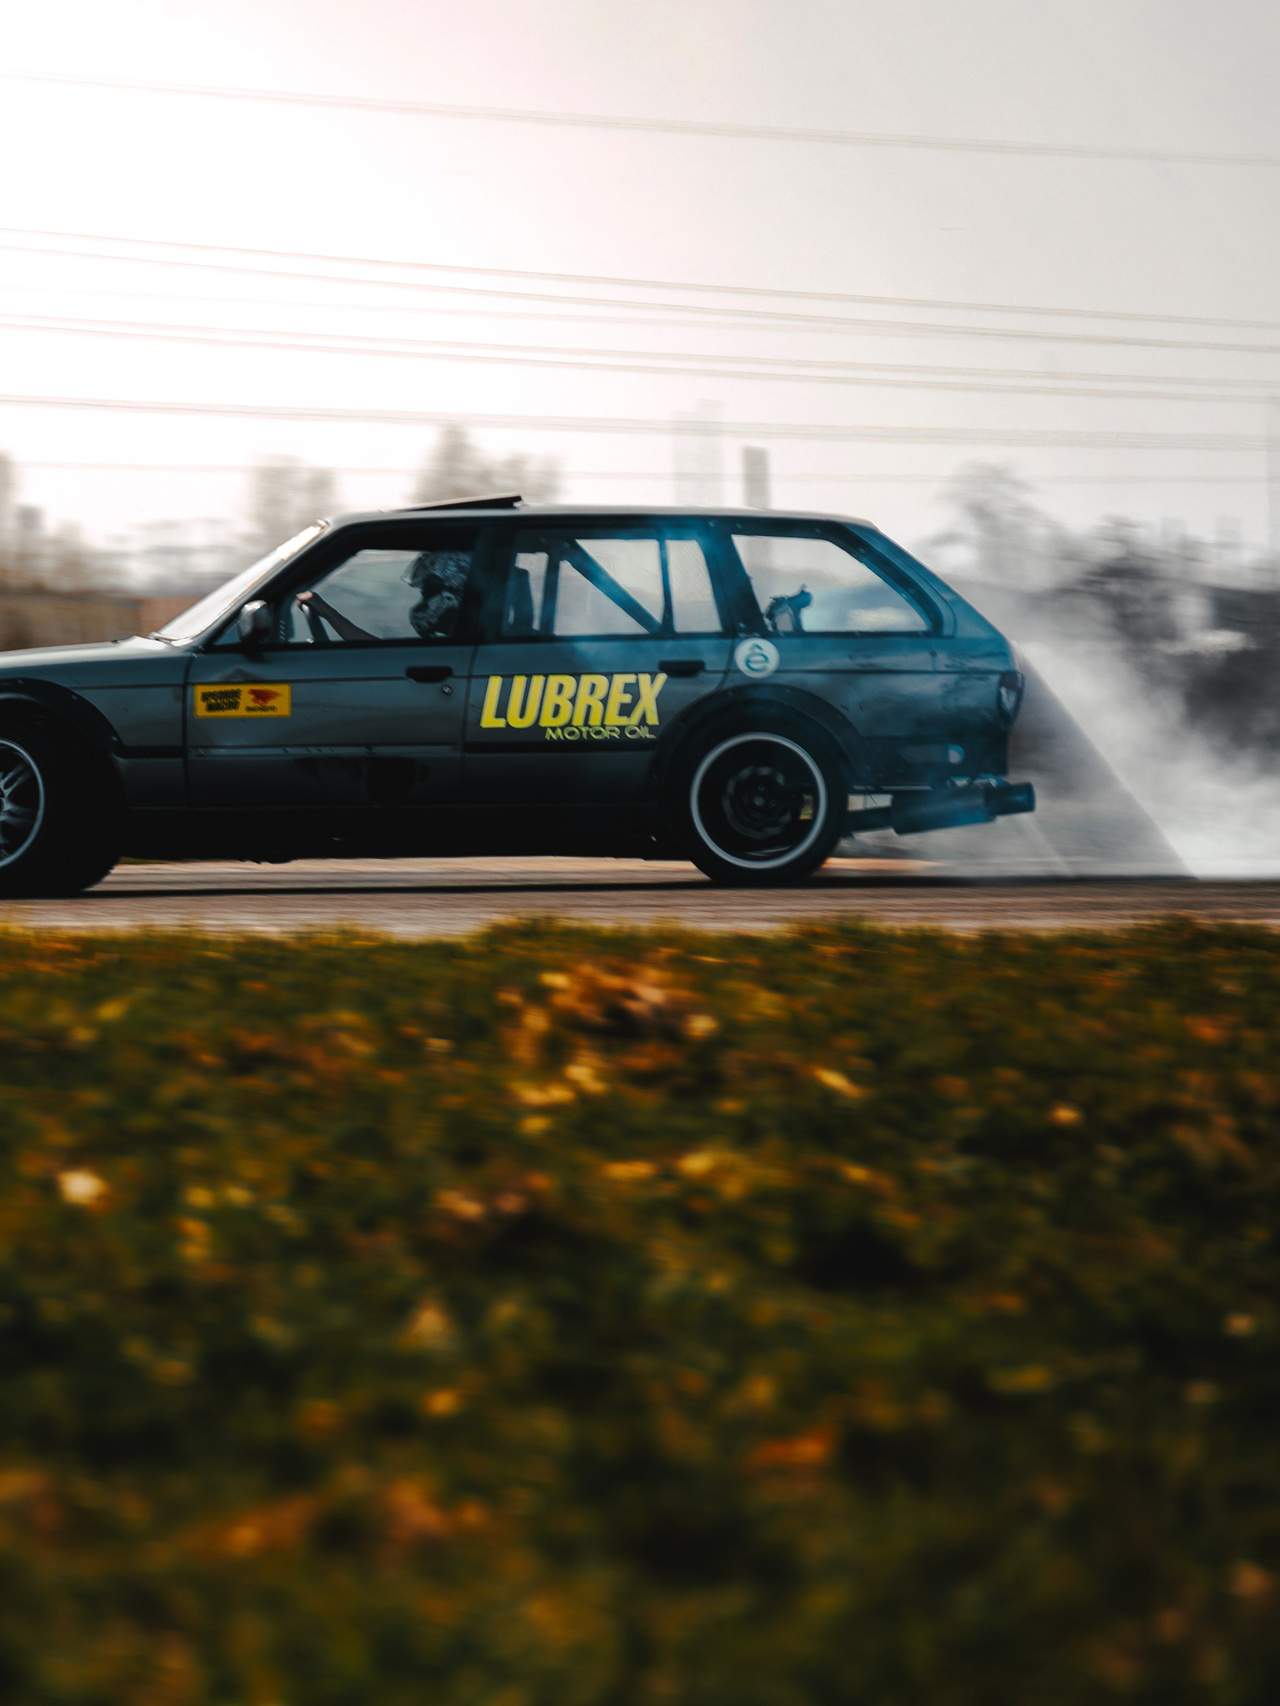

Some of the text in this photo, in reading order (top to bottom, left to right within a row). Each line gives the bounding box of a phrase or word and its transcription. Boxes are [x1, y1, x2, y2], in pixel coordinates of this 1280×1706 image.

[480, 673, 668, 728] LUBREX
[545, 726, 656, 740] MOTOR OIL
